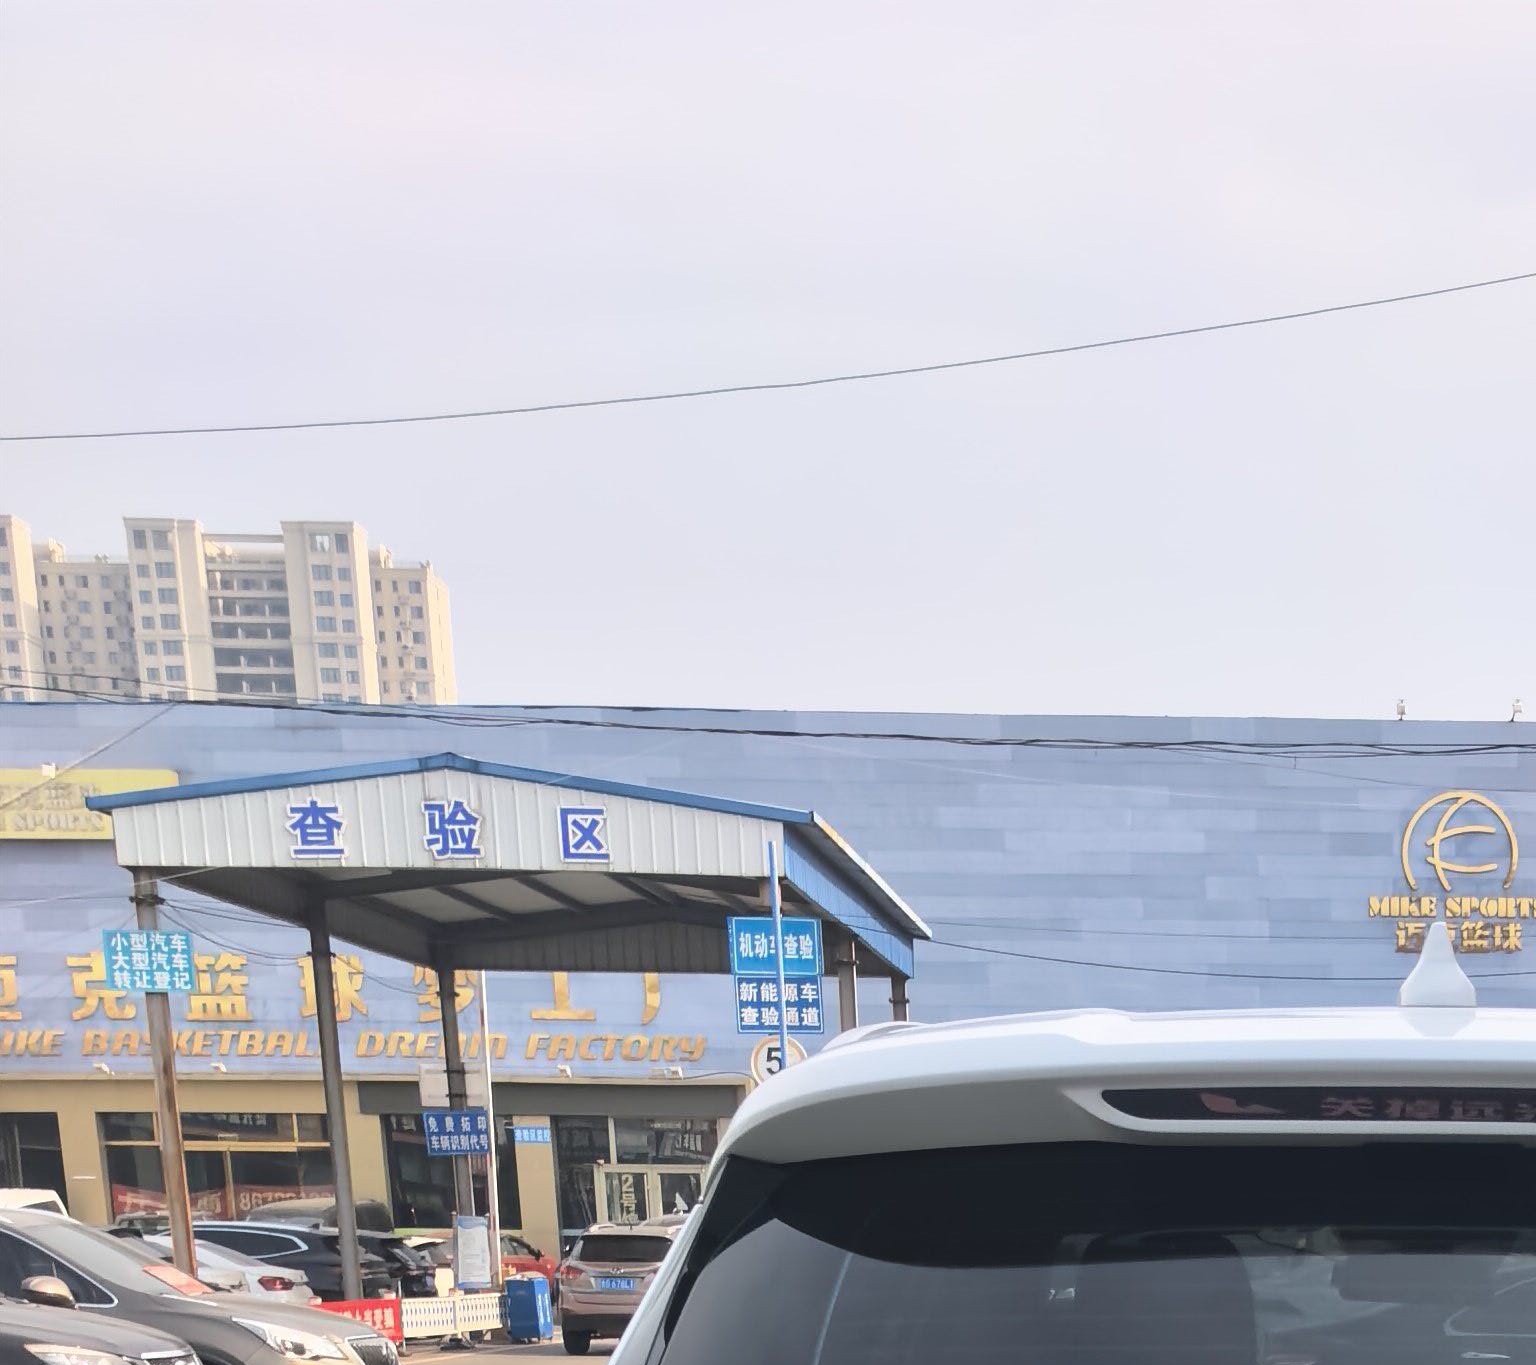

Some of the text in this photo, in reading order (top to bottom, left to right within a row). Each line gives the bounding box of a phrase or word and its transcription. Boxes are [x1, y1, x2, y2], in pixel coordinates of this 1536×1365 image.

[289, 799, 610, 863] 查验区
[1369, 895, 1437, 918] MIKE
[111, 932, 188, 952] 小型汽车
[1396, 920, 1523, 952] 迈篮球
[112, 951, 189, 971] 大型汽车
[114, 970, 192, 990] 转让登记
[740, 982, 819, 1003] 新能源车
[742, 1006, 820, 1026] 查验通道
[525, 1032, 706, 1062] FACTORY
[766, 1047, 782, 1074] 5
[431, 1134, 488, 1151] 车辆识别代号
